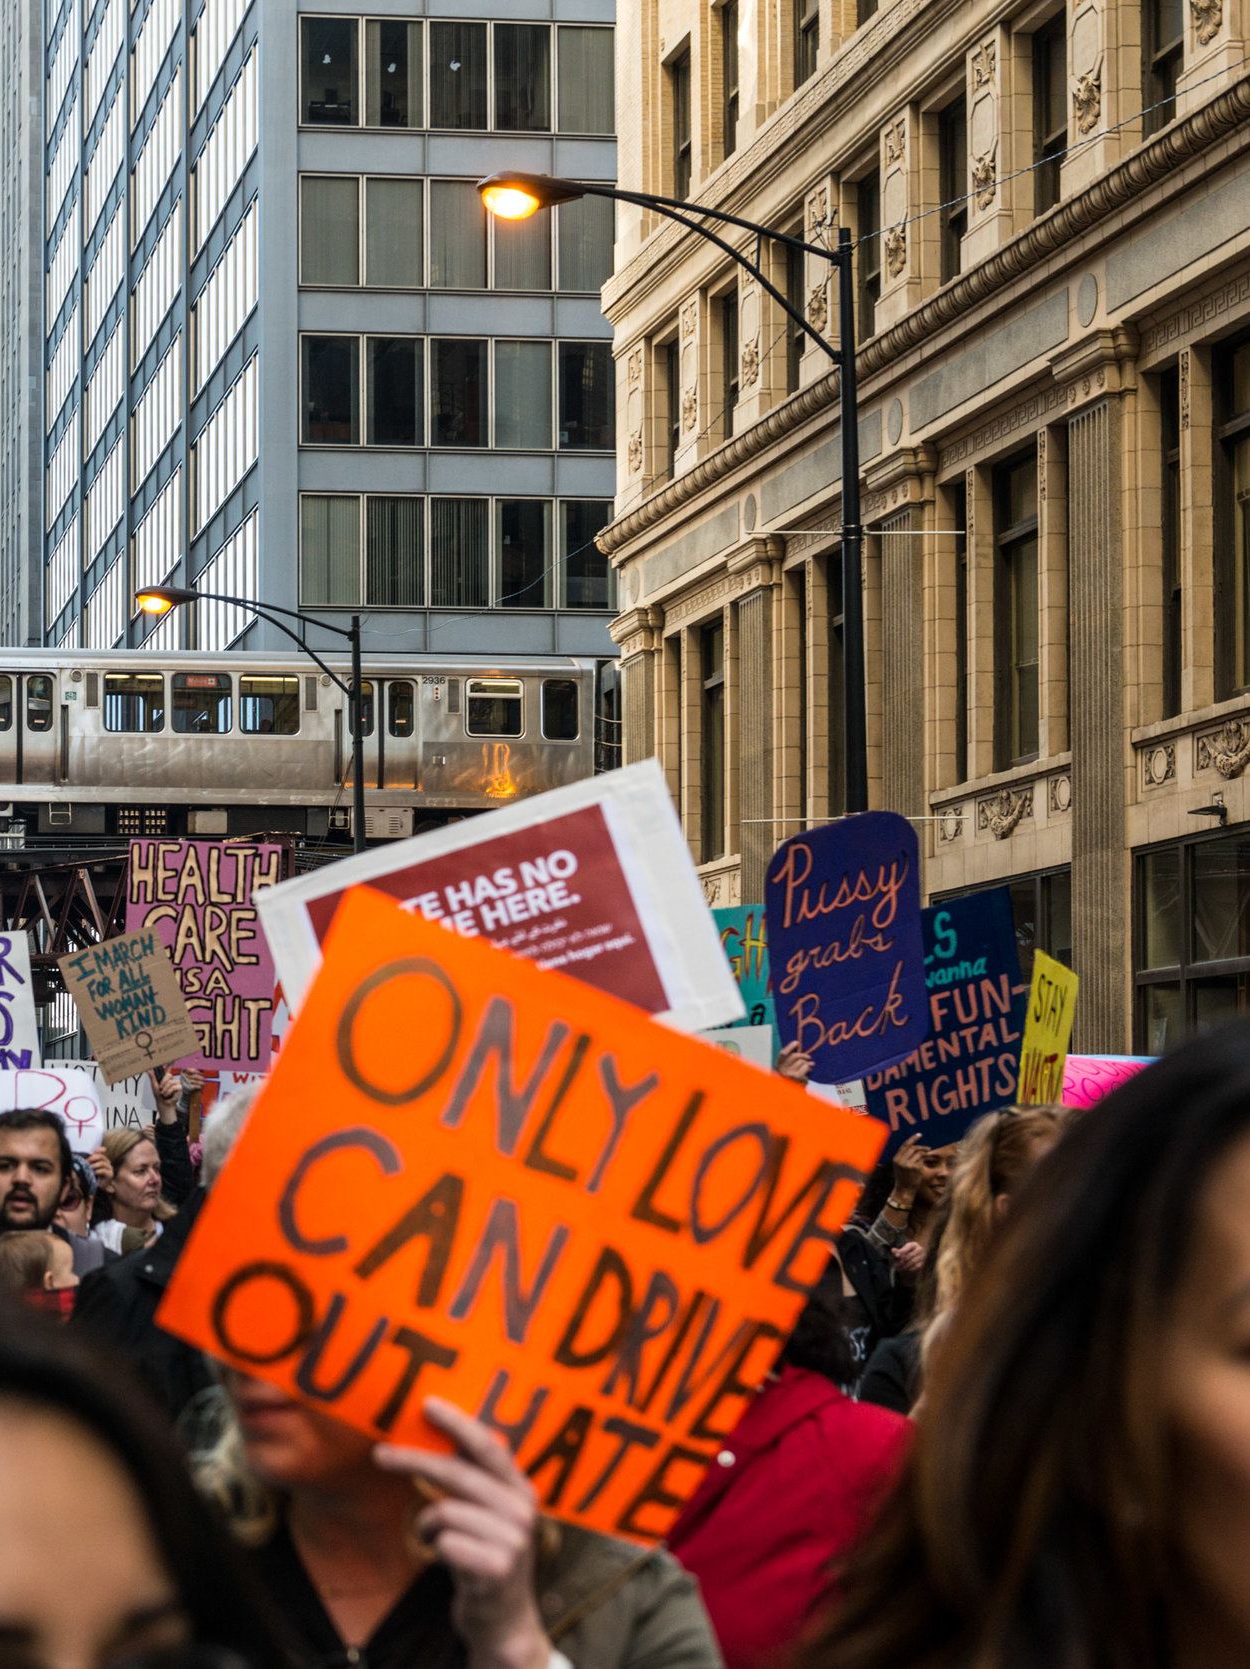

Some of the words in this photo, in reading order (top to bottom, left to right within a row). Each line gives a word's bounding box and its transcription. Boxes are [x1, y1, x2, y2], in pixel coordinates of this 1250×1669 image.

[423, 677, 446, 685] 2936
[130, 843, 280, 906] HEALTH
[444, 867, 518, 912] HAS
[519, 850, 578, 888] NO
[479, 880, 581, 931] HERE.
[771, 842, 909, 929] Pussy
[68, 952, 95, 982] I
[94, 933, 155, 975] MARCH
[144, 904, 259, 973] CARE
[780, 914, 893, 995] grabs
[86, 975, 115, 1002] FOR
[119, 963, 150, 991] ALL
[788, 960, 910, 1055] Back
[929, 973, 1025, 1032] FUN-
[1034, 973, 1068, 1037] STAY
[115, 1006, 166, 1039] KIND
[107, 1104, 142, 1130] INA
[885, 1053, 1016, 1131] RIGHTS
[336, 957, 658, 1194] ONLY
[631, 1090, 867, 1294] LOVE
[278, 1126, 569, 1345] CAN
[553, 1245, 789, 1442] DRIVE
[211, 1260, 460, 1433] OUT
[478, 1368, 720, 1539] HATE
